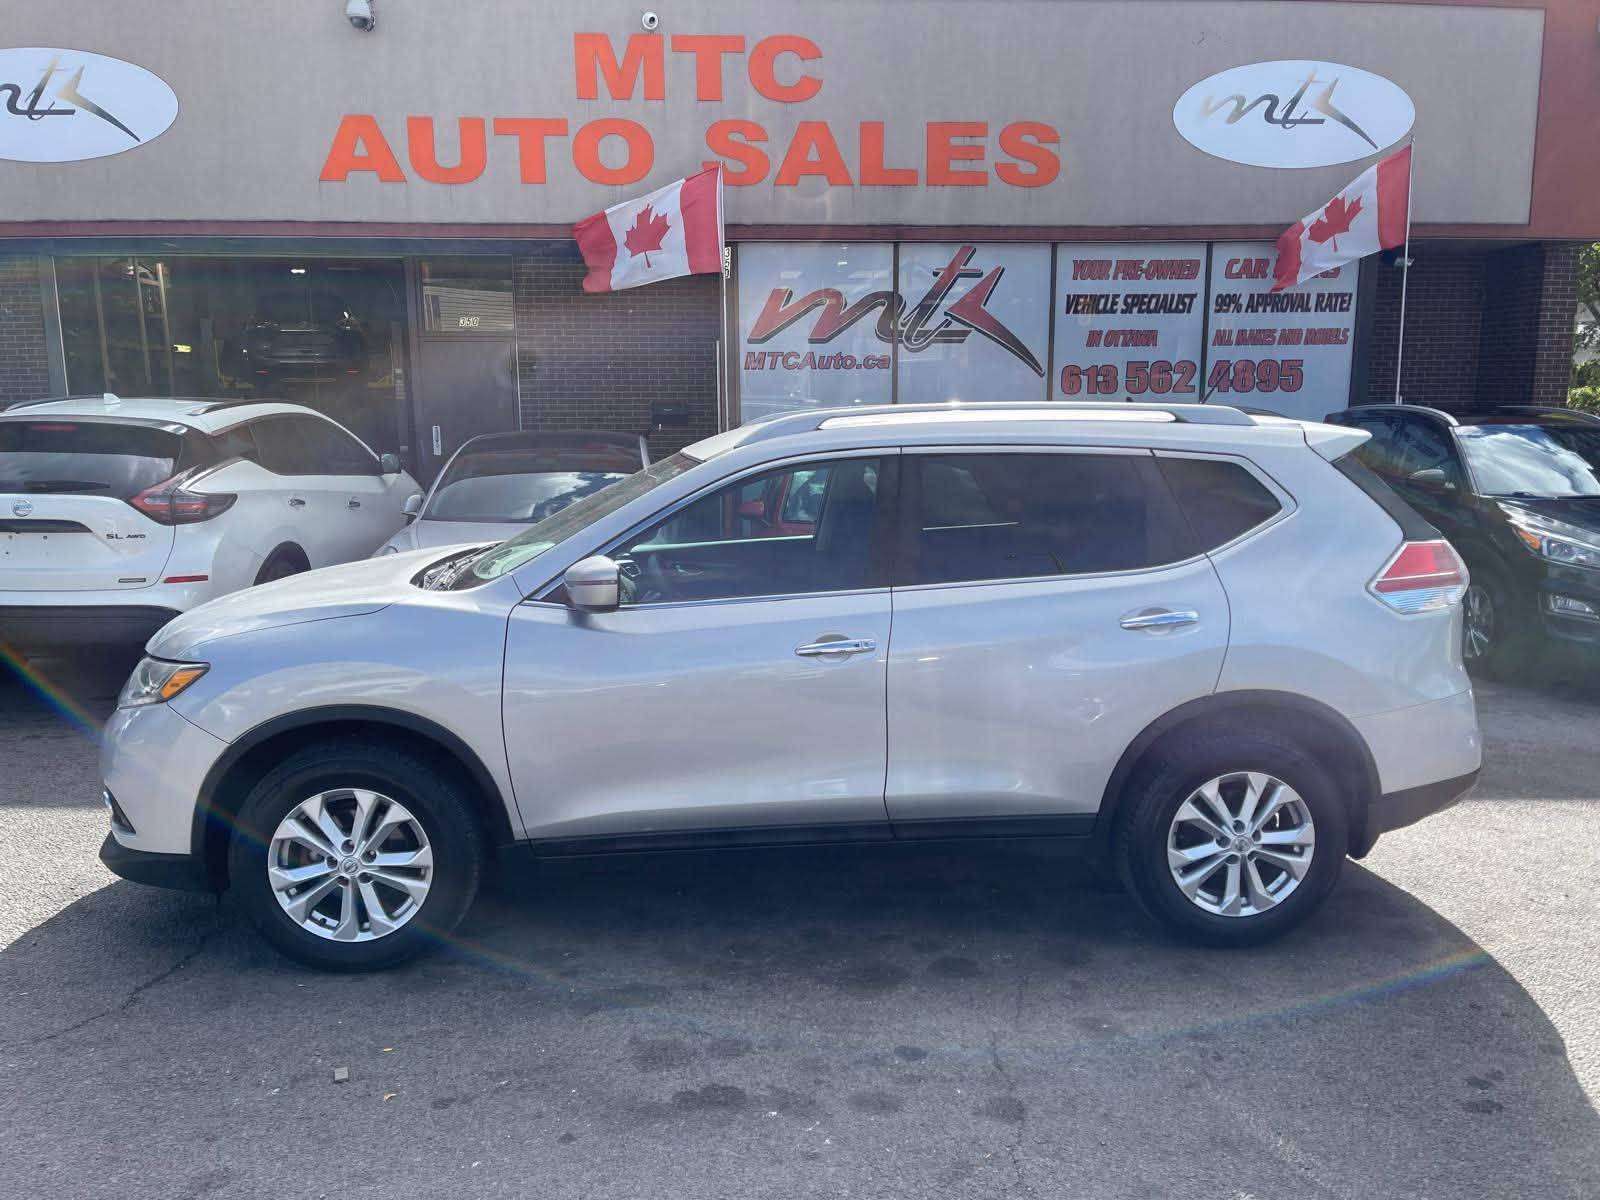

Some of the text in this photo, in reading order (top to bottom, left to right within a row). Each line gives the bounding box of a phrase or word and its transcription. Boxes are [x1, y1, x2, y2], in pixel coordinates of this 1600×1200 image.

[574, 32, 824, 103] MTC
[319, 114, 1061, 188] AUTO SALES
[1072, 259, 1201, 280] YOUR PRE-OWNED
[1224, 258, 1270, 279] CAR
[1065, 293, 1198, 315] VEHICLE SPECIALIST
[1214, 292, 1353, 313] 99% APPROVAL RATE!
[1085, 329, 1158, 347] IN OTTAWA
[1212, 327, 1351, 346] ALL MAKES AND MODELS
[743, 351, 891, 371] MTCAuto.ca
[1060, 358, 1304, 394] 613 562 4895
